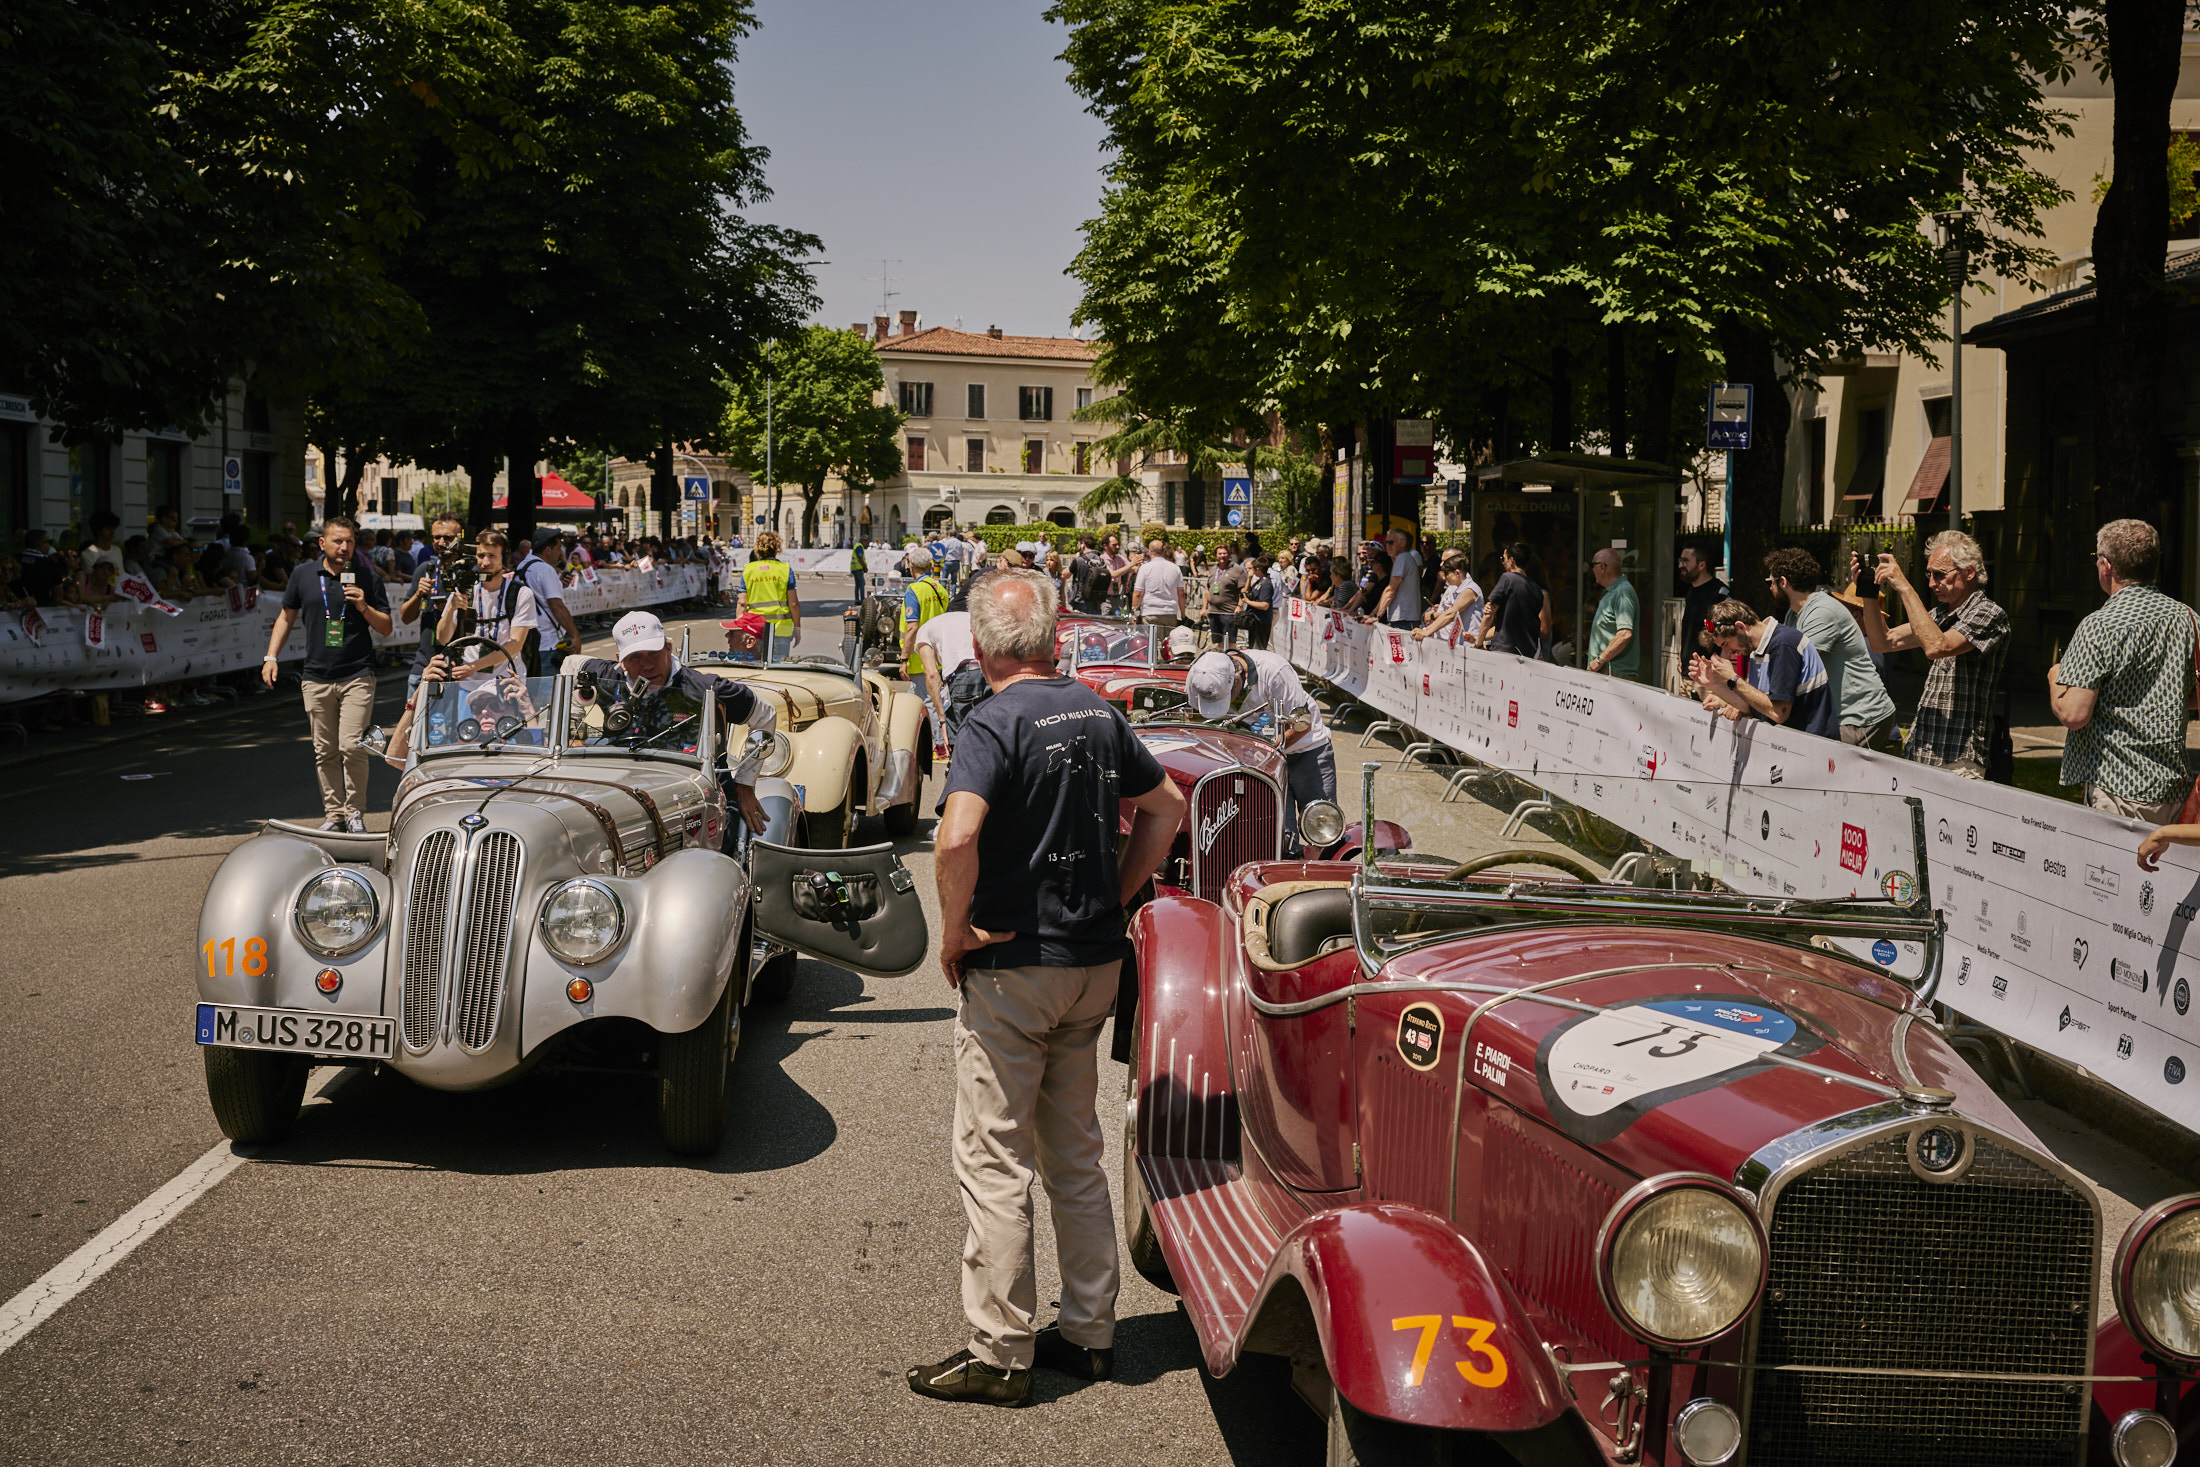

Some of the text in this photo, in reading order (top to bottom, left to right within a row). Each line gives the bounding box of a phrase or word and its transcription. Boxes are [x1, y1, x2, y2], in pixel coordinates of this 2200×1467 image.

[1485, 501, 1571, 513] CALZEDONIA
[200, 609, 228, 622] CHOPARD
[1555, 690, 1594, 716] CHOPARD
[1067, 711, 1093, 722] MIGLIA
[686, 819, 702, 830] SPORTS
[2022, 815, 2030, 824] Race
[2031, 818, 2042, 828] Friend
[1843, 827, 1862, 848] 1000
[1048, 853, 1058, 862] 13
[1840, 848, 1862, 871] MIGLIA
[2175, 902, 2196, 921] ZICO
[2112, 923, 2154, 948] 1000 Miglia Charity
[202, 937, 268, 978] 118
[1977, 944, 2001, 960] Media Partner
[2108, 1002, 2137, 1022] Sport Partner
[202, 1028, 209, 1040] D
[216, 1011, 237, 1043] M
[257, 1014, 298, 1047] US
[1405, 1028, 1417, 1045] 43
[1476, 1041, 1511, 1071] E. PIARDI
[1474, 1058, 1507, 1087] L. PALINI
[1573, 1062, 1612, 1076] CHOPARD
[2168, 1063, 2181, 1076] FIVA
[1391, 1314, 1508, 1388] 73
